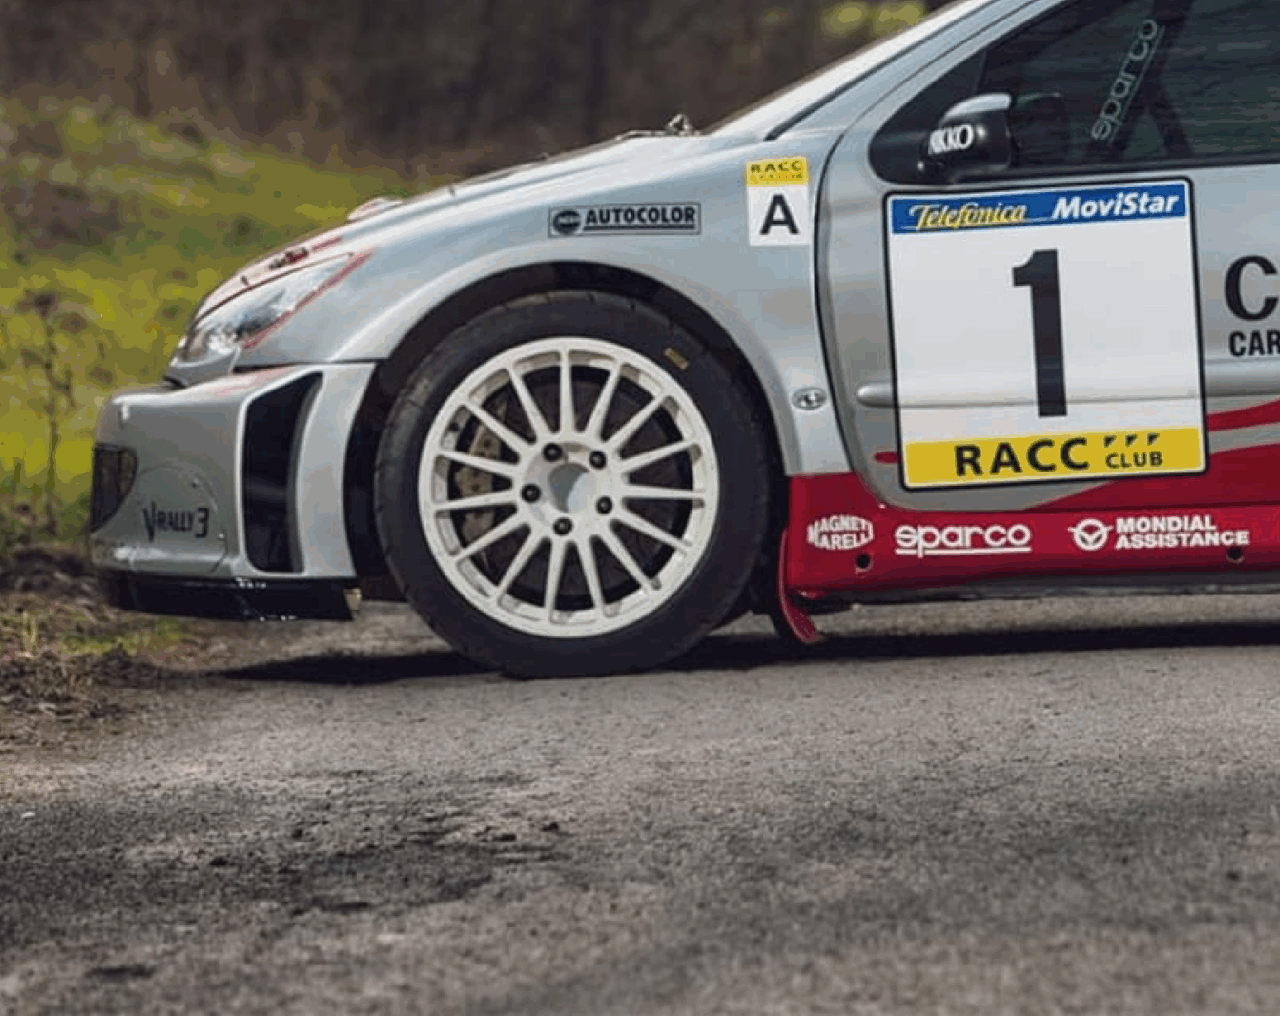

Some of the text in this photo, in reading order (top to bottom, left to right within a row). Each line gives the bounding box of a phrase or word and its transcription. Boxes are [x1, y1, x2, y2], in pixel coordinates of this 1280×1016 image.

[1091, 19, 1159, 141] sparco
[585, 206, 696, 225] AUTOCOLOR
[760, 193, 801, 235] A
[1052, 193, 1179, 219] MoviStar
[1012, 249, 1067, 417] 1
[954, 438, 1163, 477] RACC CLUB
[895, 524, 1031, 558] sparco
[1115, 530, 1250, 550] ASSISTANCE
[1116, 515, 1216, 534] MONDIAL
